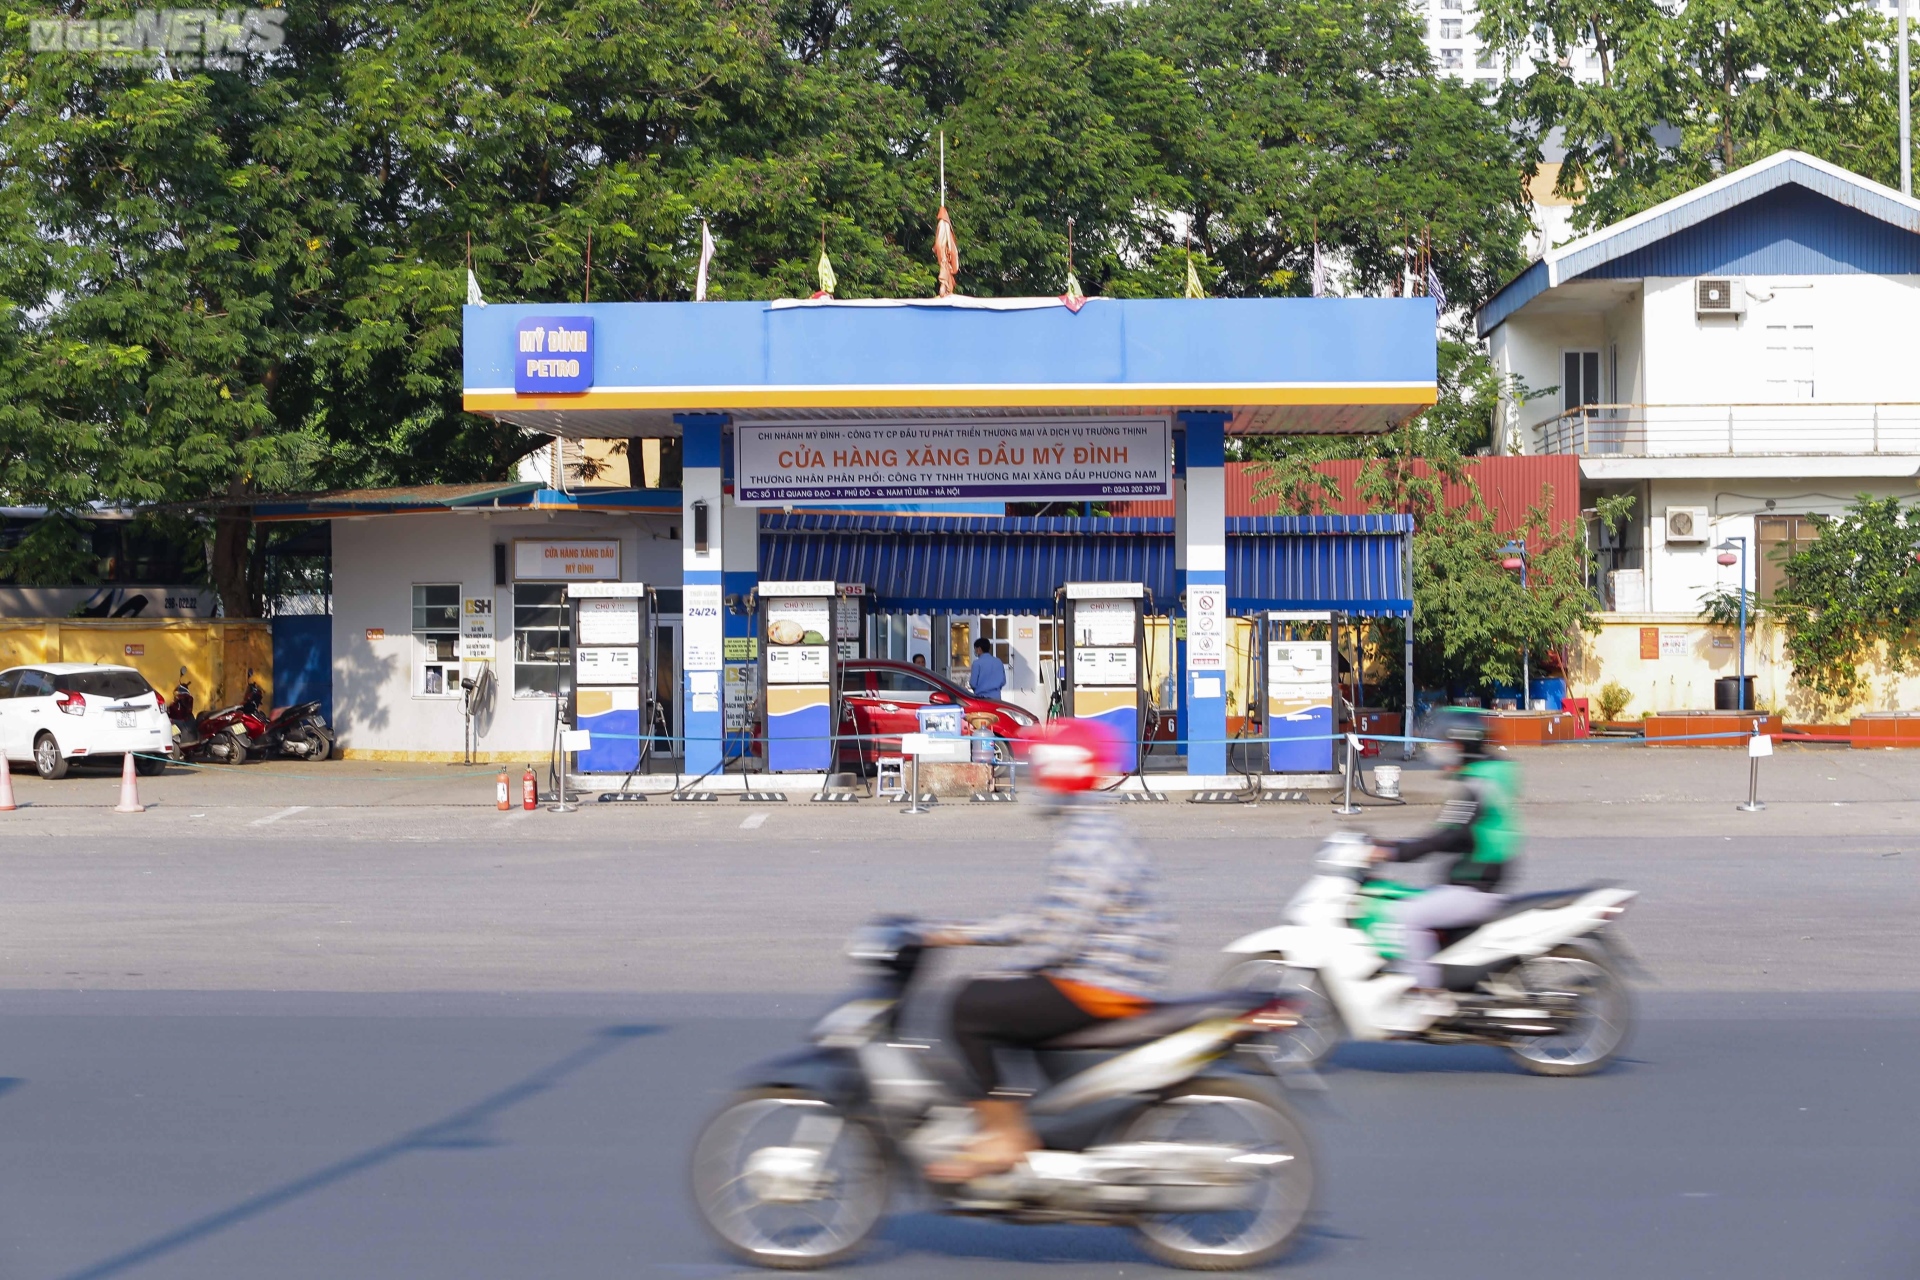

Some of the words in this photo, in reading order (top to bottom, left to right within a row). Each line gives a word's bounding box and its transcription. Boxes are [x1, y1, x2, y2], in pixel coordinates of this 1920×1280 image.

[520, 326, 546, 352] MỸ
[548, 326, 588, 352] ĐÌNH
[526, 359, 580, 378] PETRO
[758, 432, 772, 440] CHI
[775, 430, 803, 440] NHÁNH
[806, 430, 818, 439] MỸ
[820, 430, 840, 439] ĐÌNH
[848, 430, 870, 439] CÔNG
[874, 430, 884, 438] TY
[900, 428, 916, 438] ĐẦU
[920, 428, 930, 438] TƯ
[932, 428, 954, 438] PHÁT
[956, 426, 980, 438] TRIỂN
[983, 428, 1018, 437] THƯƠNG
[1020, 428, 1034, 438] MẠI
[1036, 426, 1048, 436] VÀ
[1050, 428, 1070, 438] DỊCH
[1072, 428, 1083, 437] VỤ
[1086, 426, 1120, 436] TRƯỜNG
[1122, 427, 1148, 436] THỊNH
[778, 444, 826, 468] CỬA
[834, 445, 898, 468] HÀNG
[906, 444, 970, 467] XĂNG
[978, 440, 1024, 466] DẦU
[1032, 443, 1065, 464] MỸ
[1074, 442, 1128, 464] ĐÌNH
[750, 474, 792, 484] THƯƠNG
[796, 473, 824, 483] NHÂN
[828, 472, 855, 482] PHÂN
[858, 471, 884, 482] PHỐI:
[888, 472, 917, 482] CÔNG
[920, 474, 932, 482] TY
[936, 473, 964, 482] TNHH
[966, 472, 1008, 480] THƯƠNG
[1012, 472, 1030, 482] MẠI
[1033, 470, 1061, 480] XĂNG
[1065, 468, 1086, 480] DẦU
[1088, 470, 1132, 479] PHƯƠNG
[1134, 470, 1156, 478] NAM
[760, 488, 770, 498] SỐ
[777, 489, 785, 498] LÊ
[814, 490, 830, 498] ĐẠO
[859, 488, 870, 497] ĐÔ
[913, 487, 929, 496] LIÊM
[935, 486, 945, 496] HÀ
[946, 486, 960, 496] NỘI
[545, 546, 558, 558] CỬA
[560, 546, 578, 558] HÀNG
[600, 546, 614, 558] DẦU
[845, 585, 862, 594] 95
[465, 599, 492, 614] BSH
[688, 608, 717, 616] 24/24
[580, 652, 586, 662] 8
[610, 652, 616, 662] 7
[770, 652, 776, 661] 6
[802, 651, 807, 661] 5
[1077, 652, 1082, 662] 4
[1109, 653, 1114, 662] 3
[1168, 718, 1174, 732] 6
[1361, 718, 1367, 731] 5
[1548, 720, 1553, 734] 4
